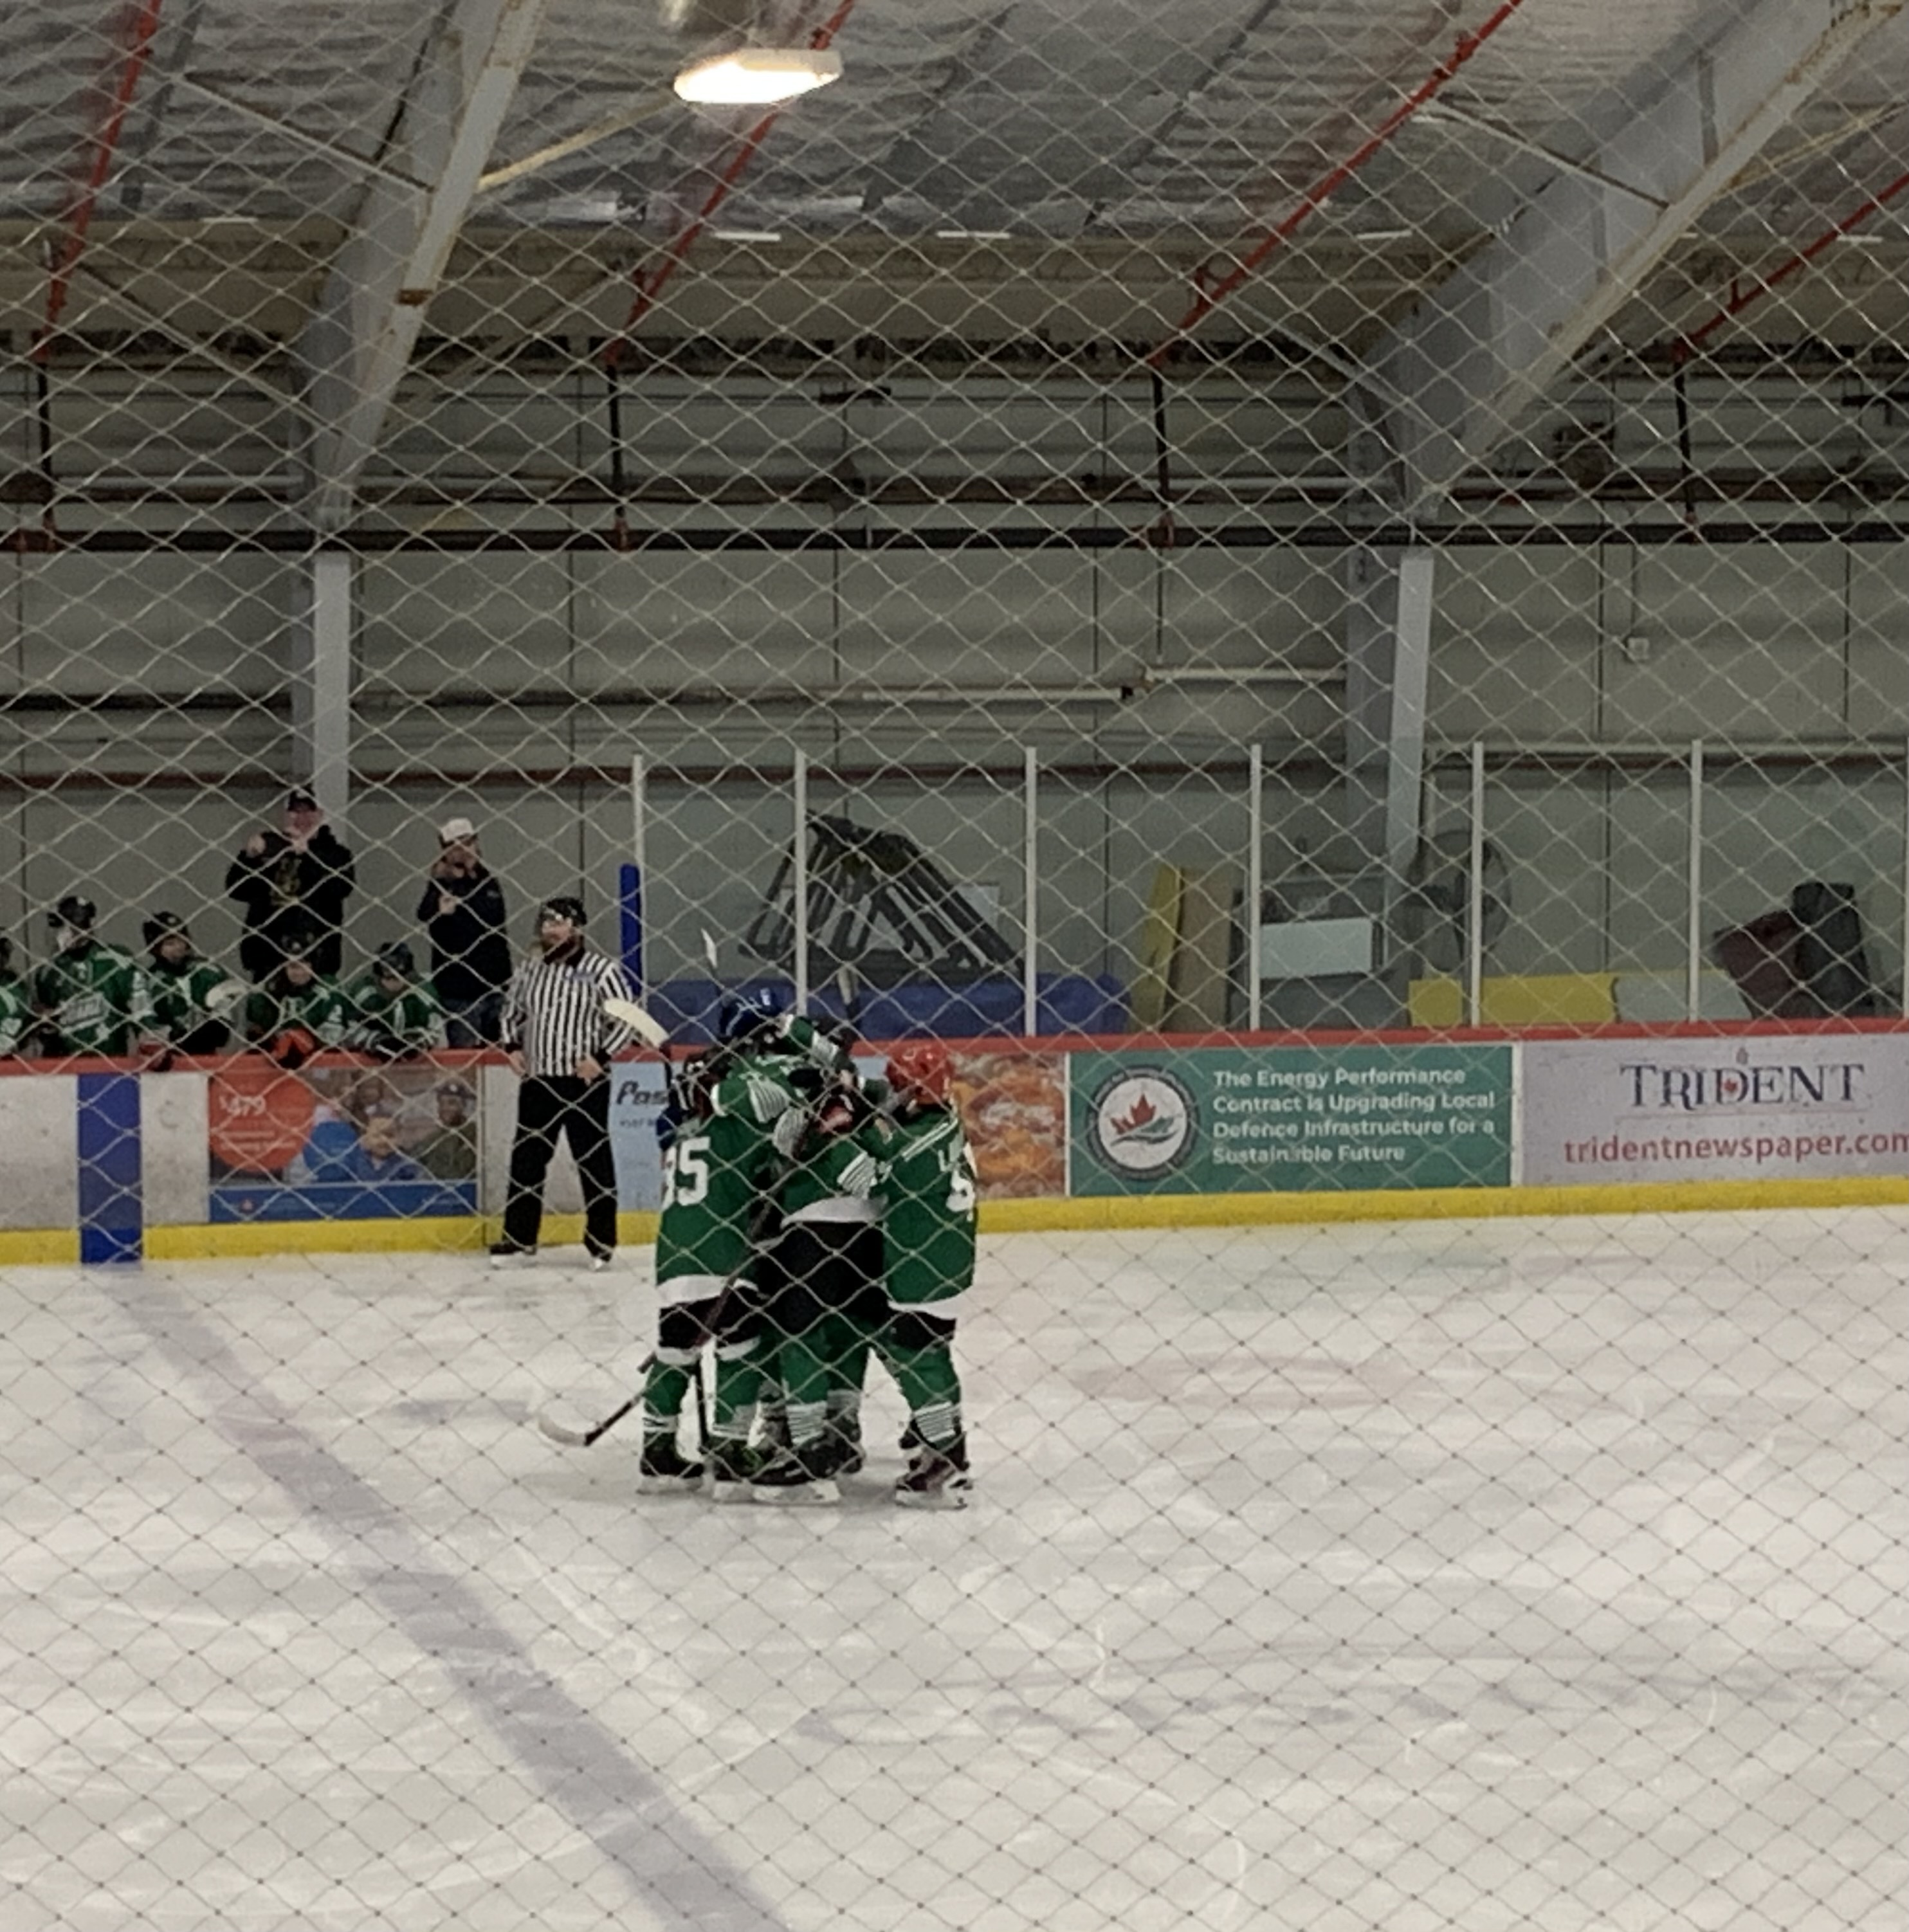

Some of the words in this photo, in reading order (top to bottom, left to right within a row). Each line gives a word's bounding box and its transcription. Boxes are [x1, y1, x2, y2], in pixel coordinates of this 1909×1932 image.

[1213, 1070, 1252, 1088] The
[1257, 1070, 1329, 1089] Energy
[1336, 1068, 1466, 1085] Performance
[1620, 1063, 1864, 1110] TRIDENT
[1213, 1096, 1301, 1113] Contract
[1329, 1093, 1436, 1114] Upgrading
[1442, 1091, 1495, 1109] Local
[1213, 1122, 1299, 1138] Defence
[1304, 1119, 1444, 1136] Infrastructure
[1449, 1116, 1475, 1134] for
[1483, 1120, 1495, 1134] a
[1338, 1144, 1406, 1161] Future
